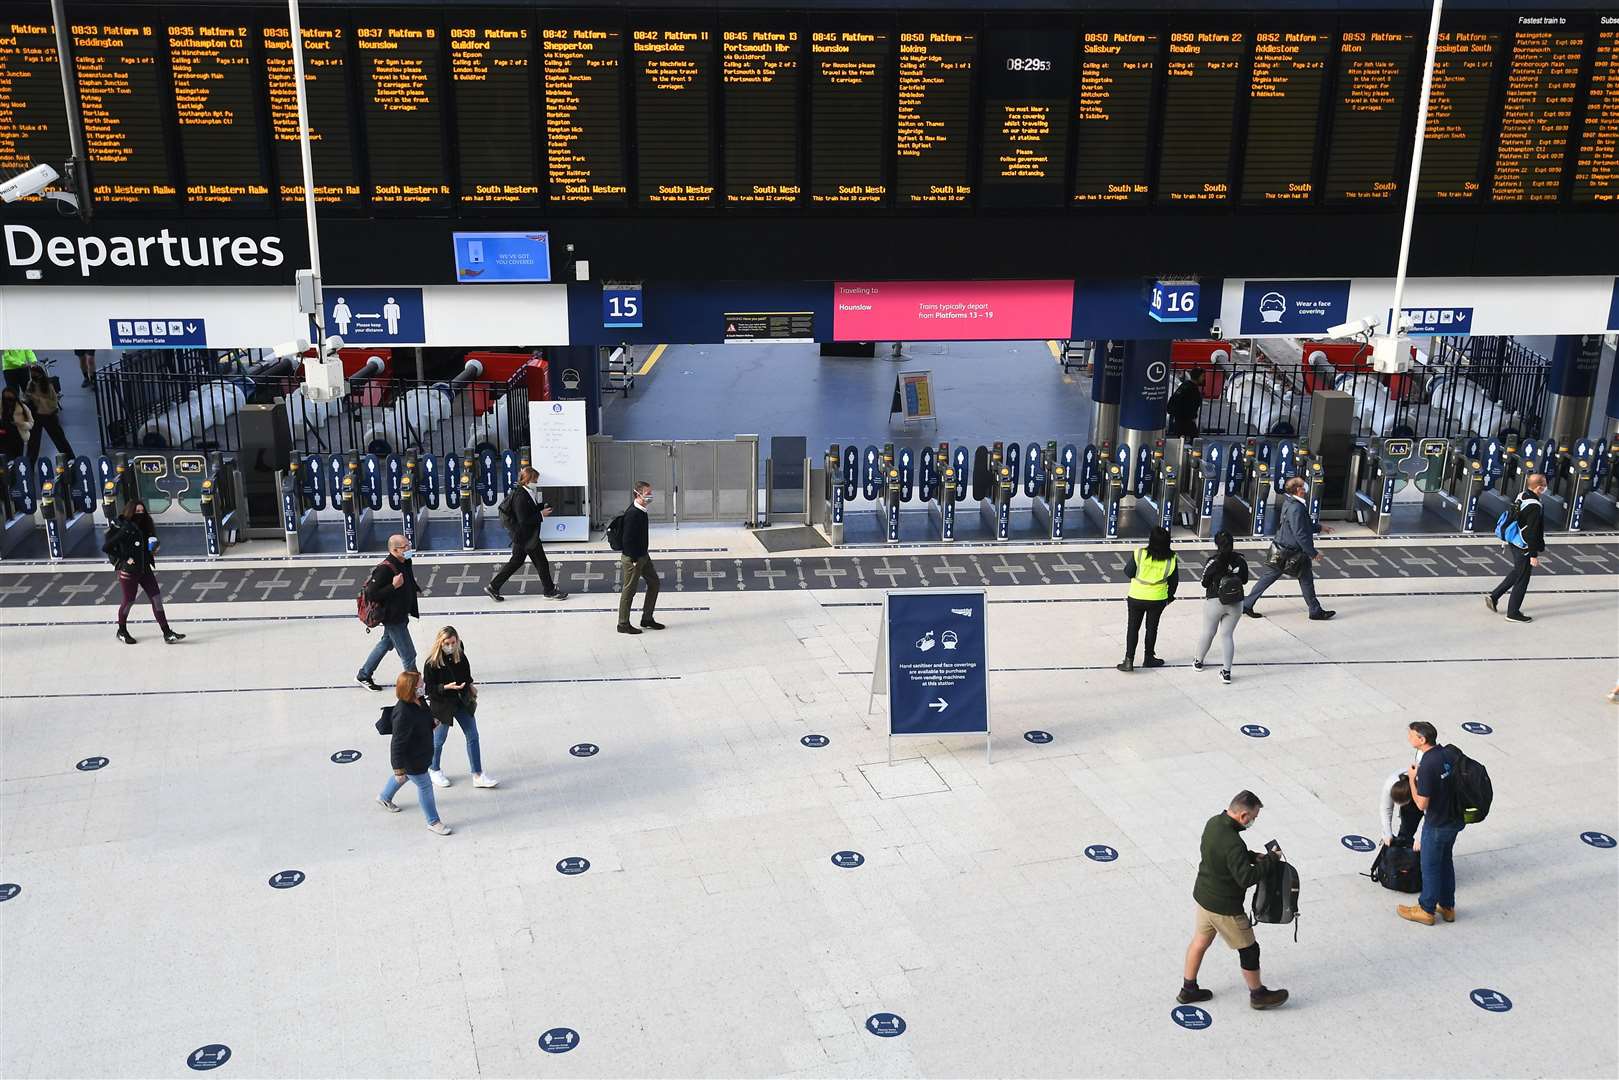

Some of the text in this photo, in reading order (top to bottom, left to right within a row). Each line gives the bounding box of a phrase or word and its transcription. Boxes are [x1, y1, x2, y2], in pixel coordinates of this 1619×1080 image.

[12, 25, 47, 34] Platform
[72, 26, 97, 35] 08:33
[104, 27, 138, 35] Platform
[168, 27, 247, 36] 08:35 Platform 12
[264, 29, 288, 37] 08:36
[358, 29, 382, 37] 08:37
[389, 30, 422, 38] Platform
[451, 30, 526, 38] 08:39 Platform 5
[634, 32, 658, 40] 08:42
[665, 32, 697, 40] Platform
[930, 34, 962, 42] Platform
[74, 38, 123, 48] Teddington
[170, 39, 227, 48] Southampton
[305, 40, 330, 49] Court
[359, 41, 397, 49] Hounslow
[452, 41, 490, 49] Guildford
[544, 42, 593, 50] Shepperton
[634, 43, 684, 51] Basingstoke
[724, 44, 772, 52] Portsmouth
[901, 45, 926, 54] Woking
[1084, 45, 1120, 54] Salisbury
[1170, 45, 1200, 54] Reading
[1256, 45, 1299, 53] Addlestone
[280, 186, 304, 194] South
[376, 186, 437, 194] South Western
[4, 224, 284, 277] Departures
[1152, 288, 1162, 310] 16
[1168, 292, 1194, 312] 16
[609, 297, 638, 317] 15
